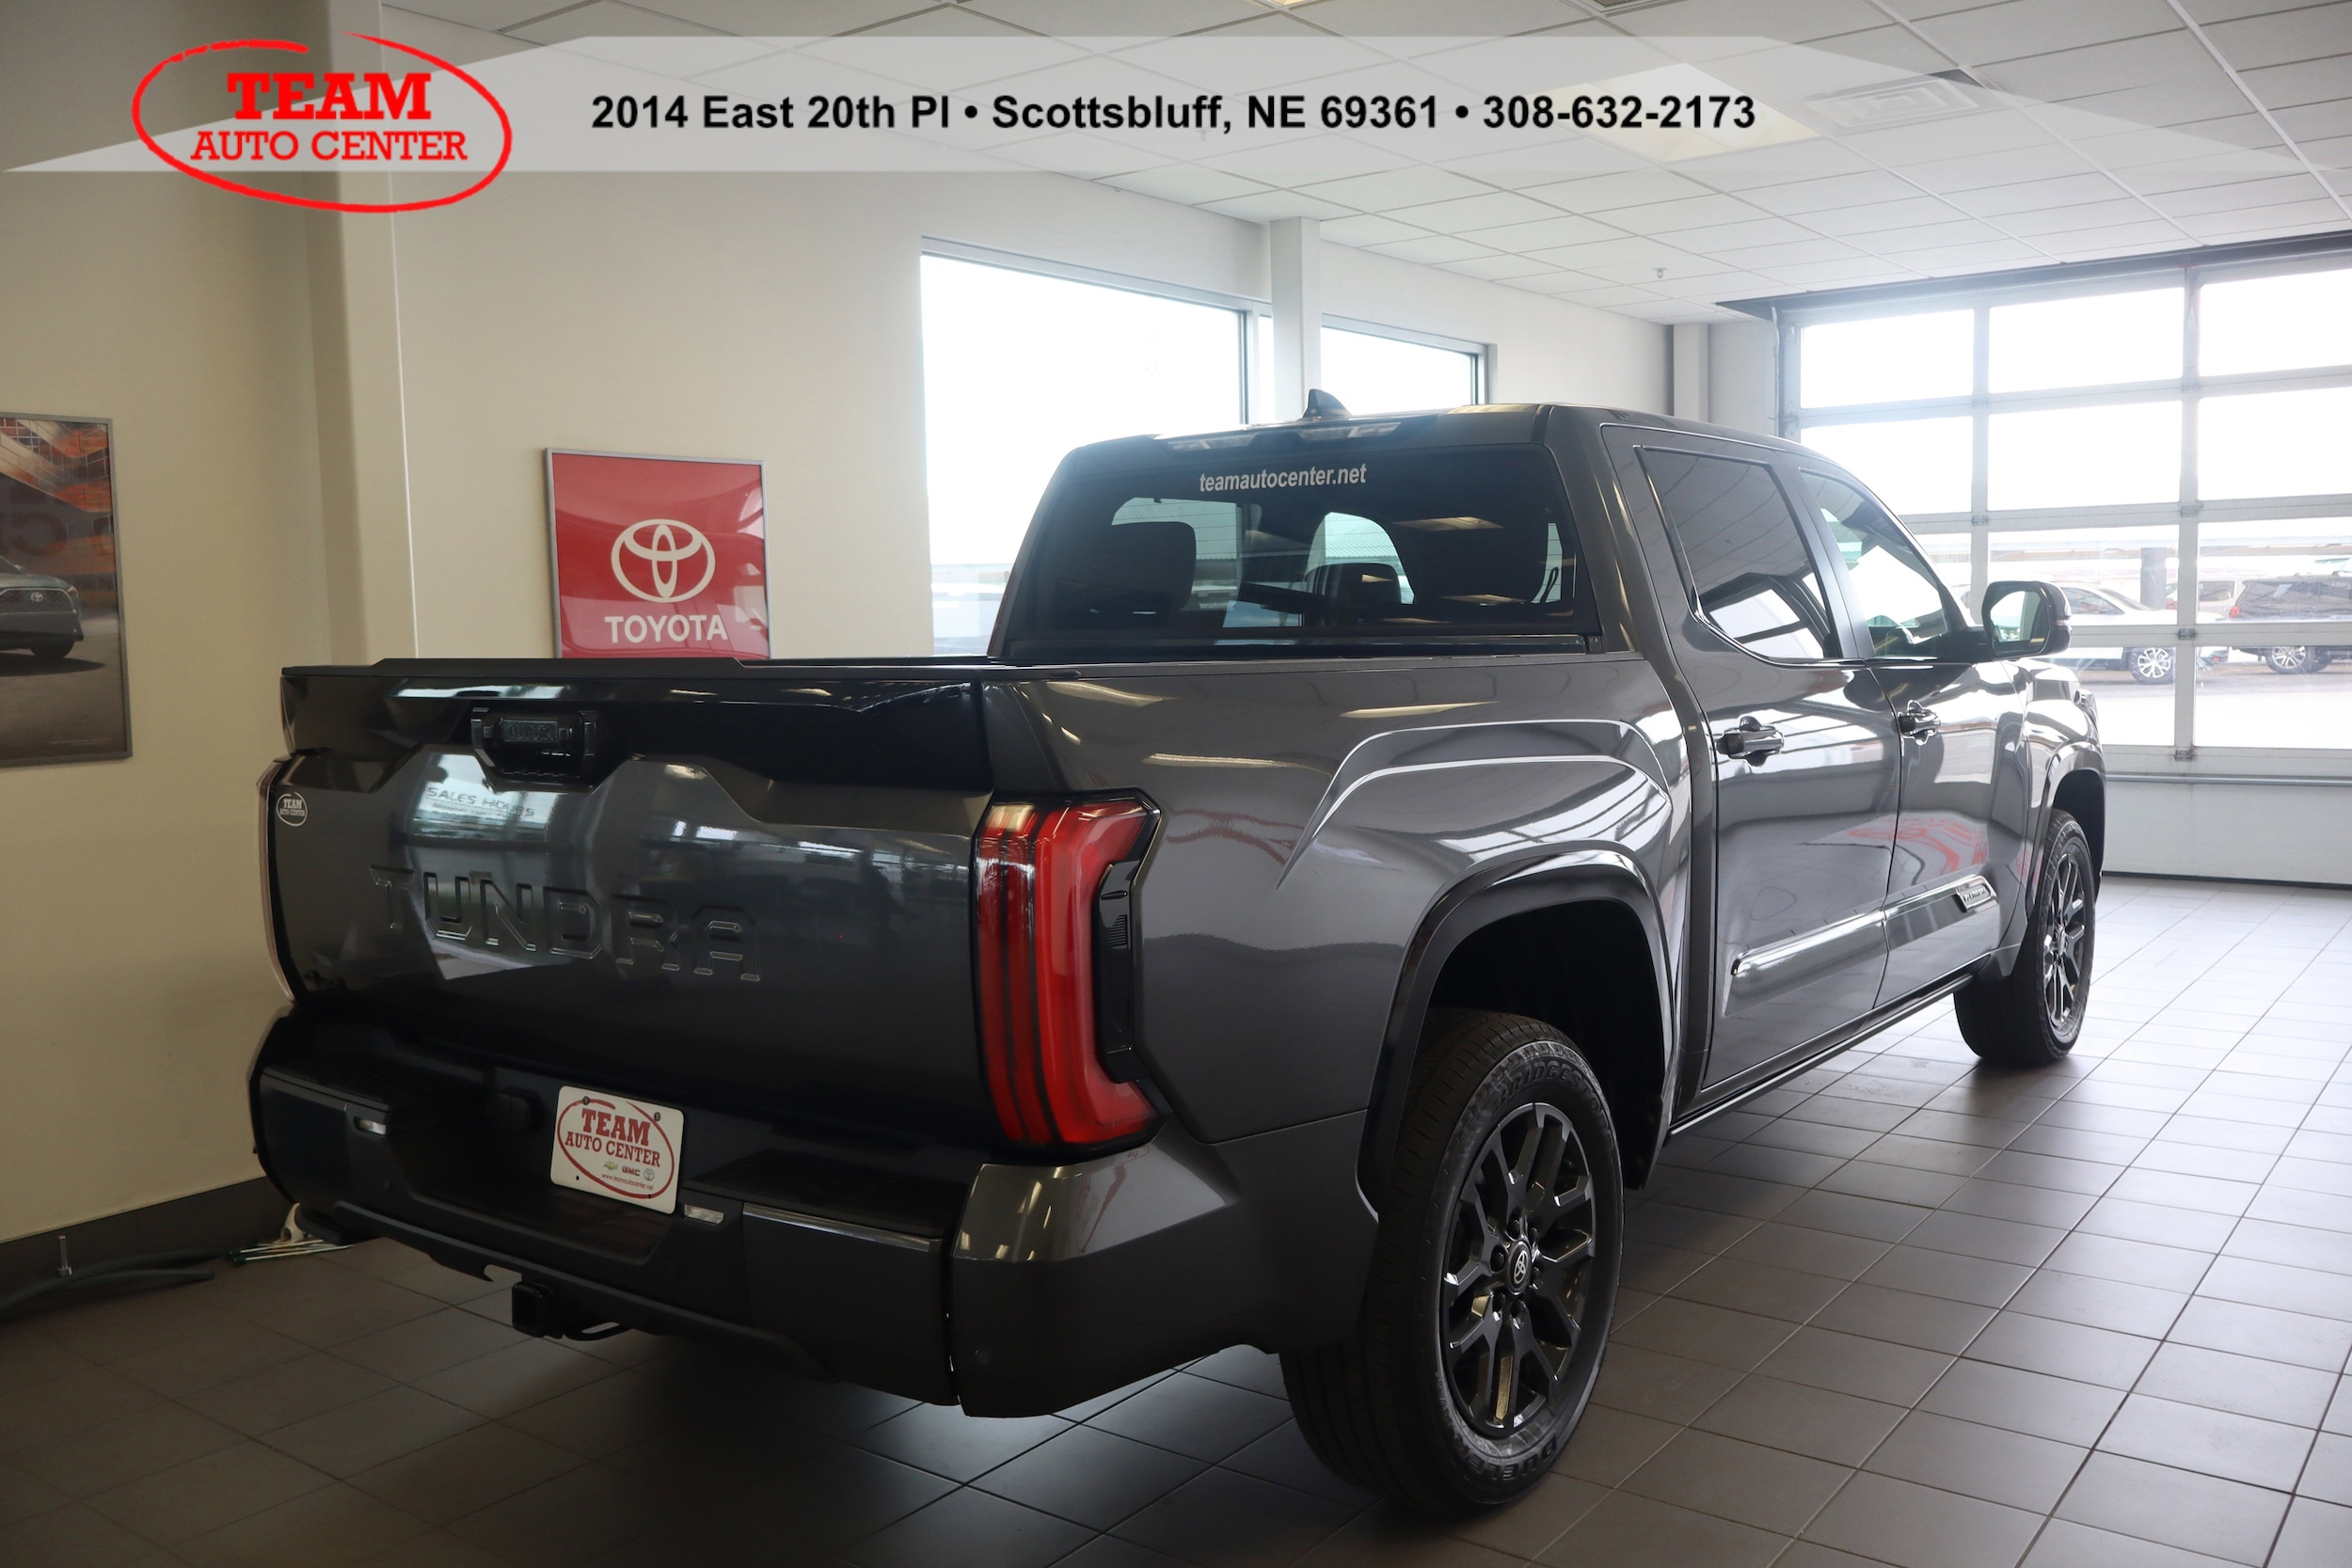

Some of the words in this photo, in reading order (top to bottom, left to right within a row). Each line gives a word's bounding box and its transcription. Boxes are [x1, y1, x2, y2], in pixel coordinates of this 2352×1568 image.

[1200, 463, 1367, 492] teamautocenter.net
[604, 614, 728, 643] TOYOTA
[283, 799, 302, 809] TEAM
[425, 786, 476, 805] SALES
[370, 866, 761, 981] TUNDRA
[581, 1108, 651, 1147] TEAM
[564, 1131, 602, 1152] AUTO
[605, 1140, 660, 1167] CENTER
[621, 1165, 641, 1177] GMC
